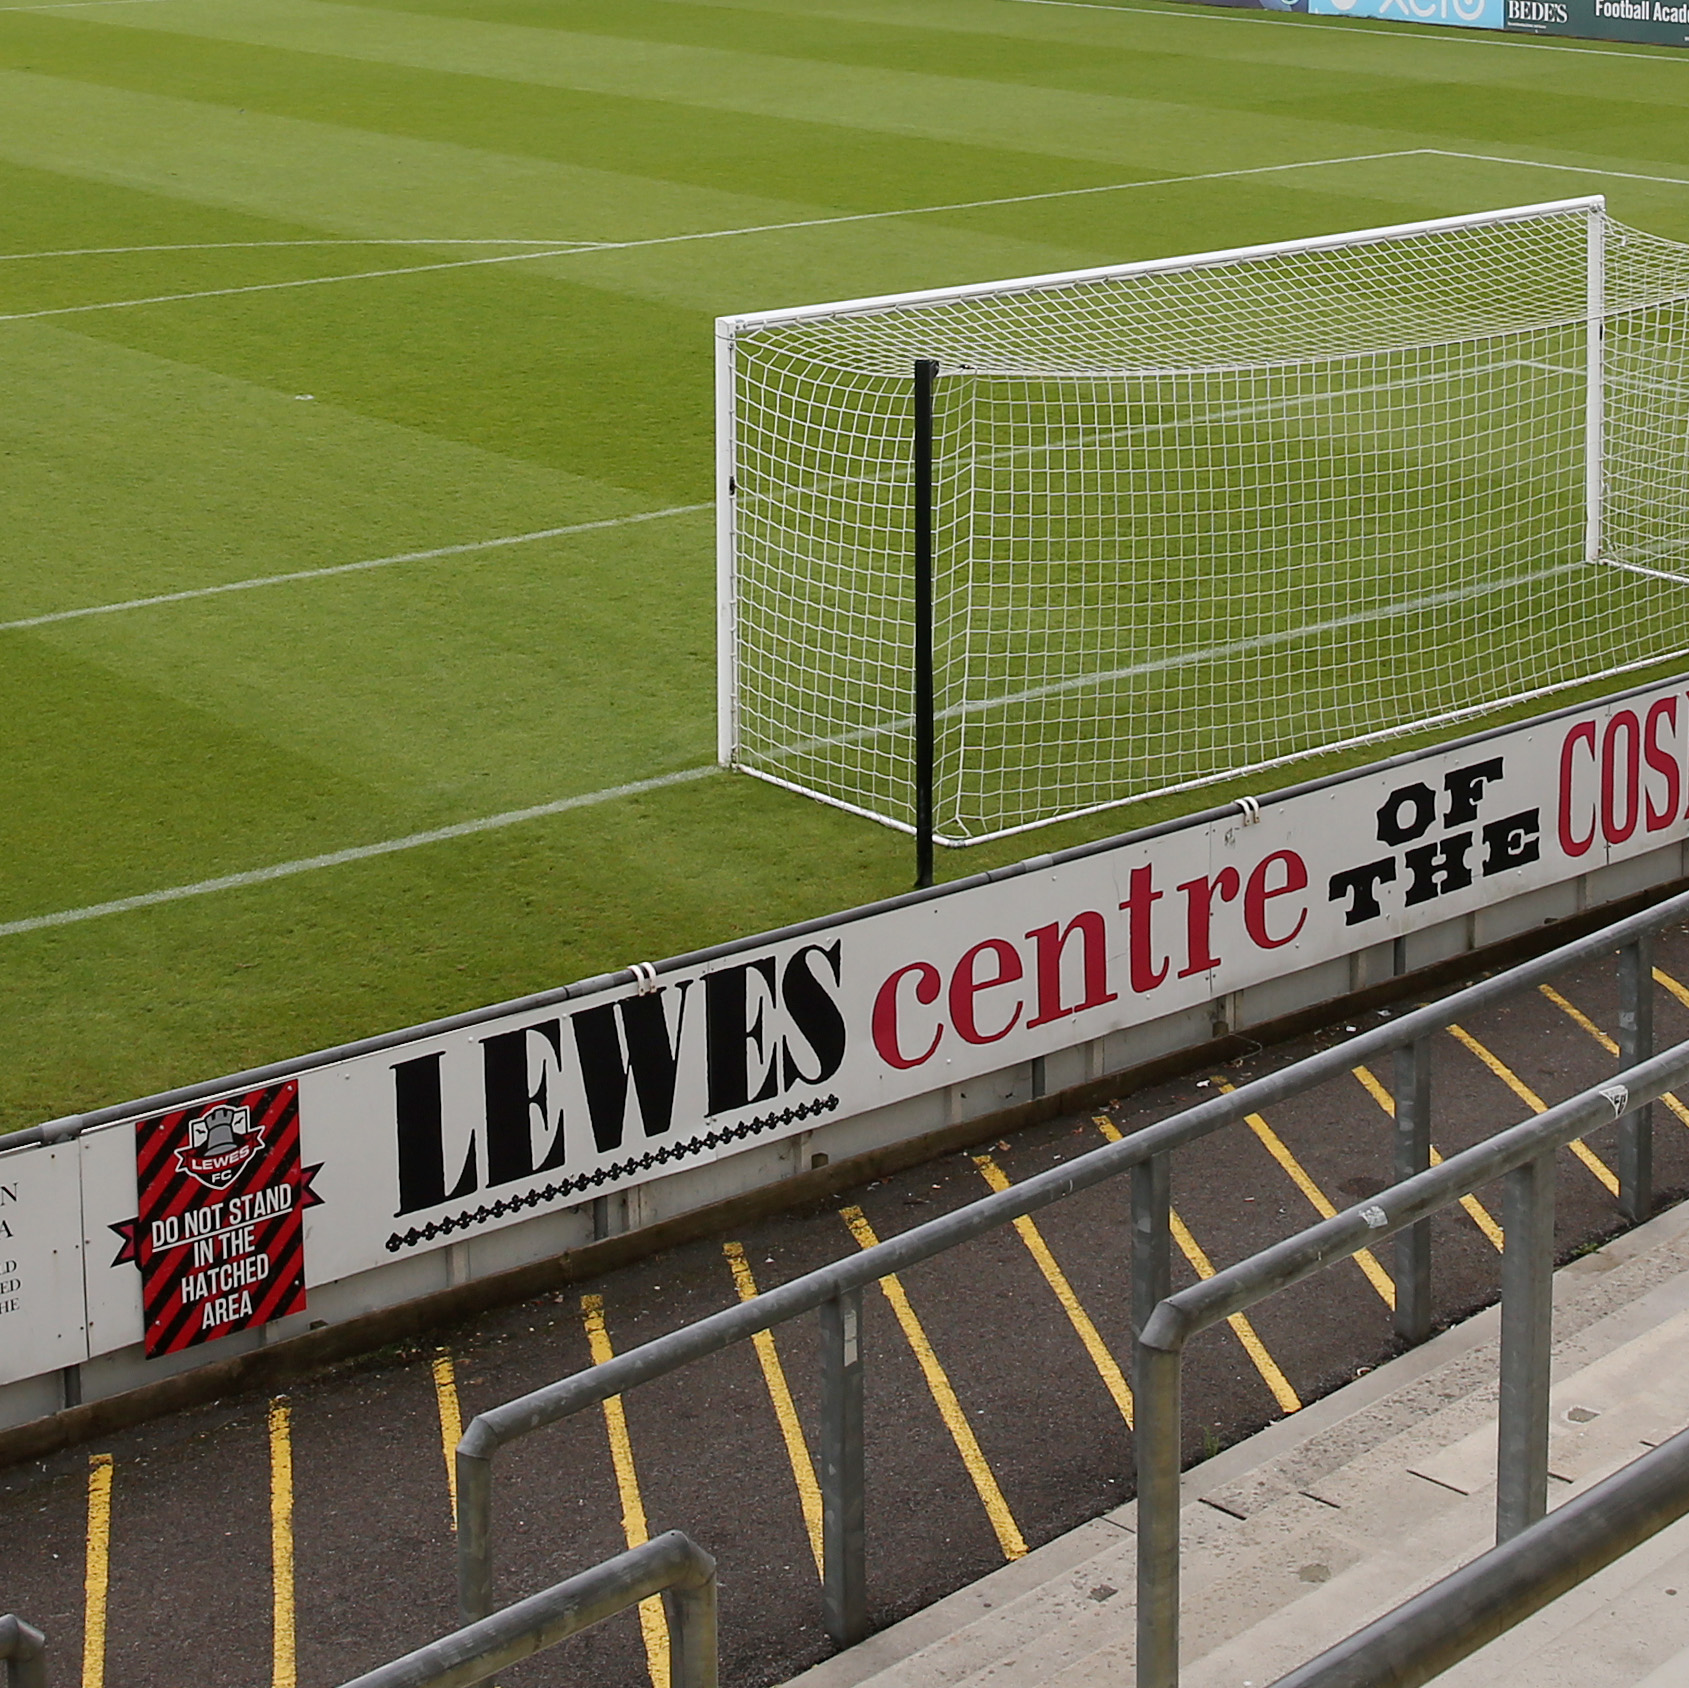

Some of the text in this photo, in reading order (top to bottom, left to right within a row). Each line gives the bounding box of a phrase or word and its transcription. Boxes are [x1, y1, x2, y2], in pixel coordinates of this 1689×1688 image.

[1508, 0, 1568, 23] BEDE'S
[1375, 756, 1504, 847] OF
[1328, 807, 1541, 927] THE
[871, 848, 1310, 1071] centre
[388, 938, 848, 1218] LEWES
[191, 1145, 251, 1170] LEWES
[212, 1171, 232, 1183] FC
[152, 1183, 292, 1249] DO NOT STAND
[194, 1225, 255, 1269] IN THE
[181, 1253, 269, 1304] HATCHED
[202, 1289, 253, 1330] AREA
